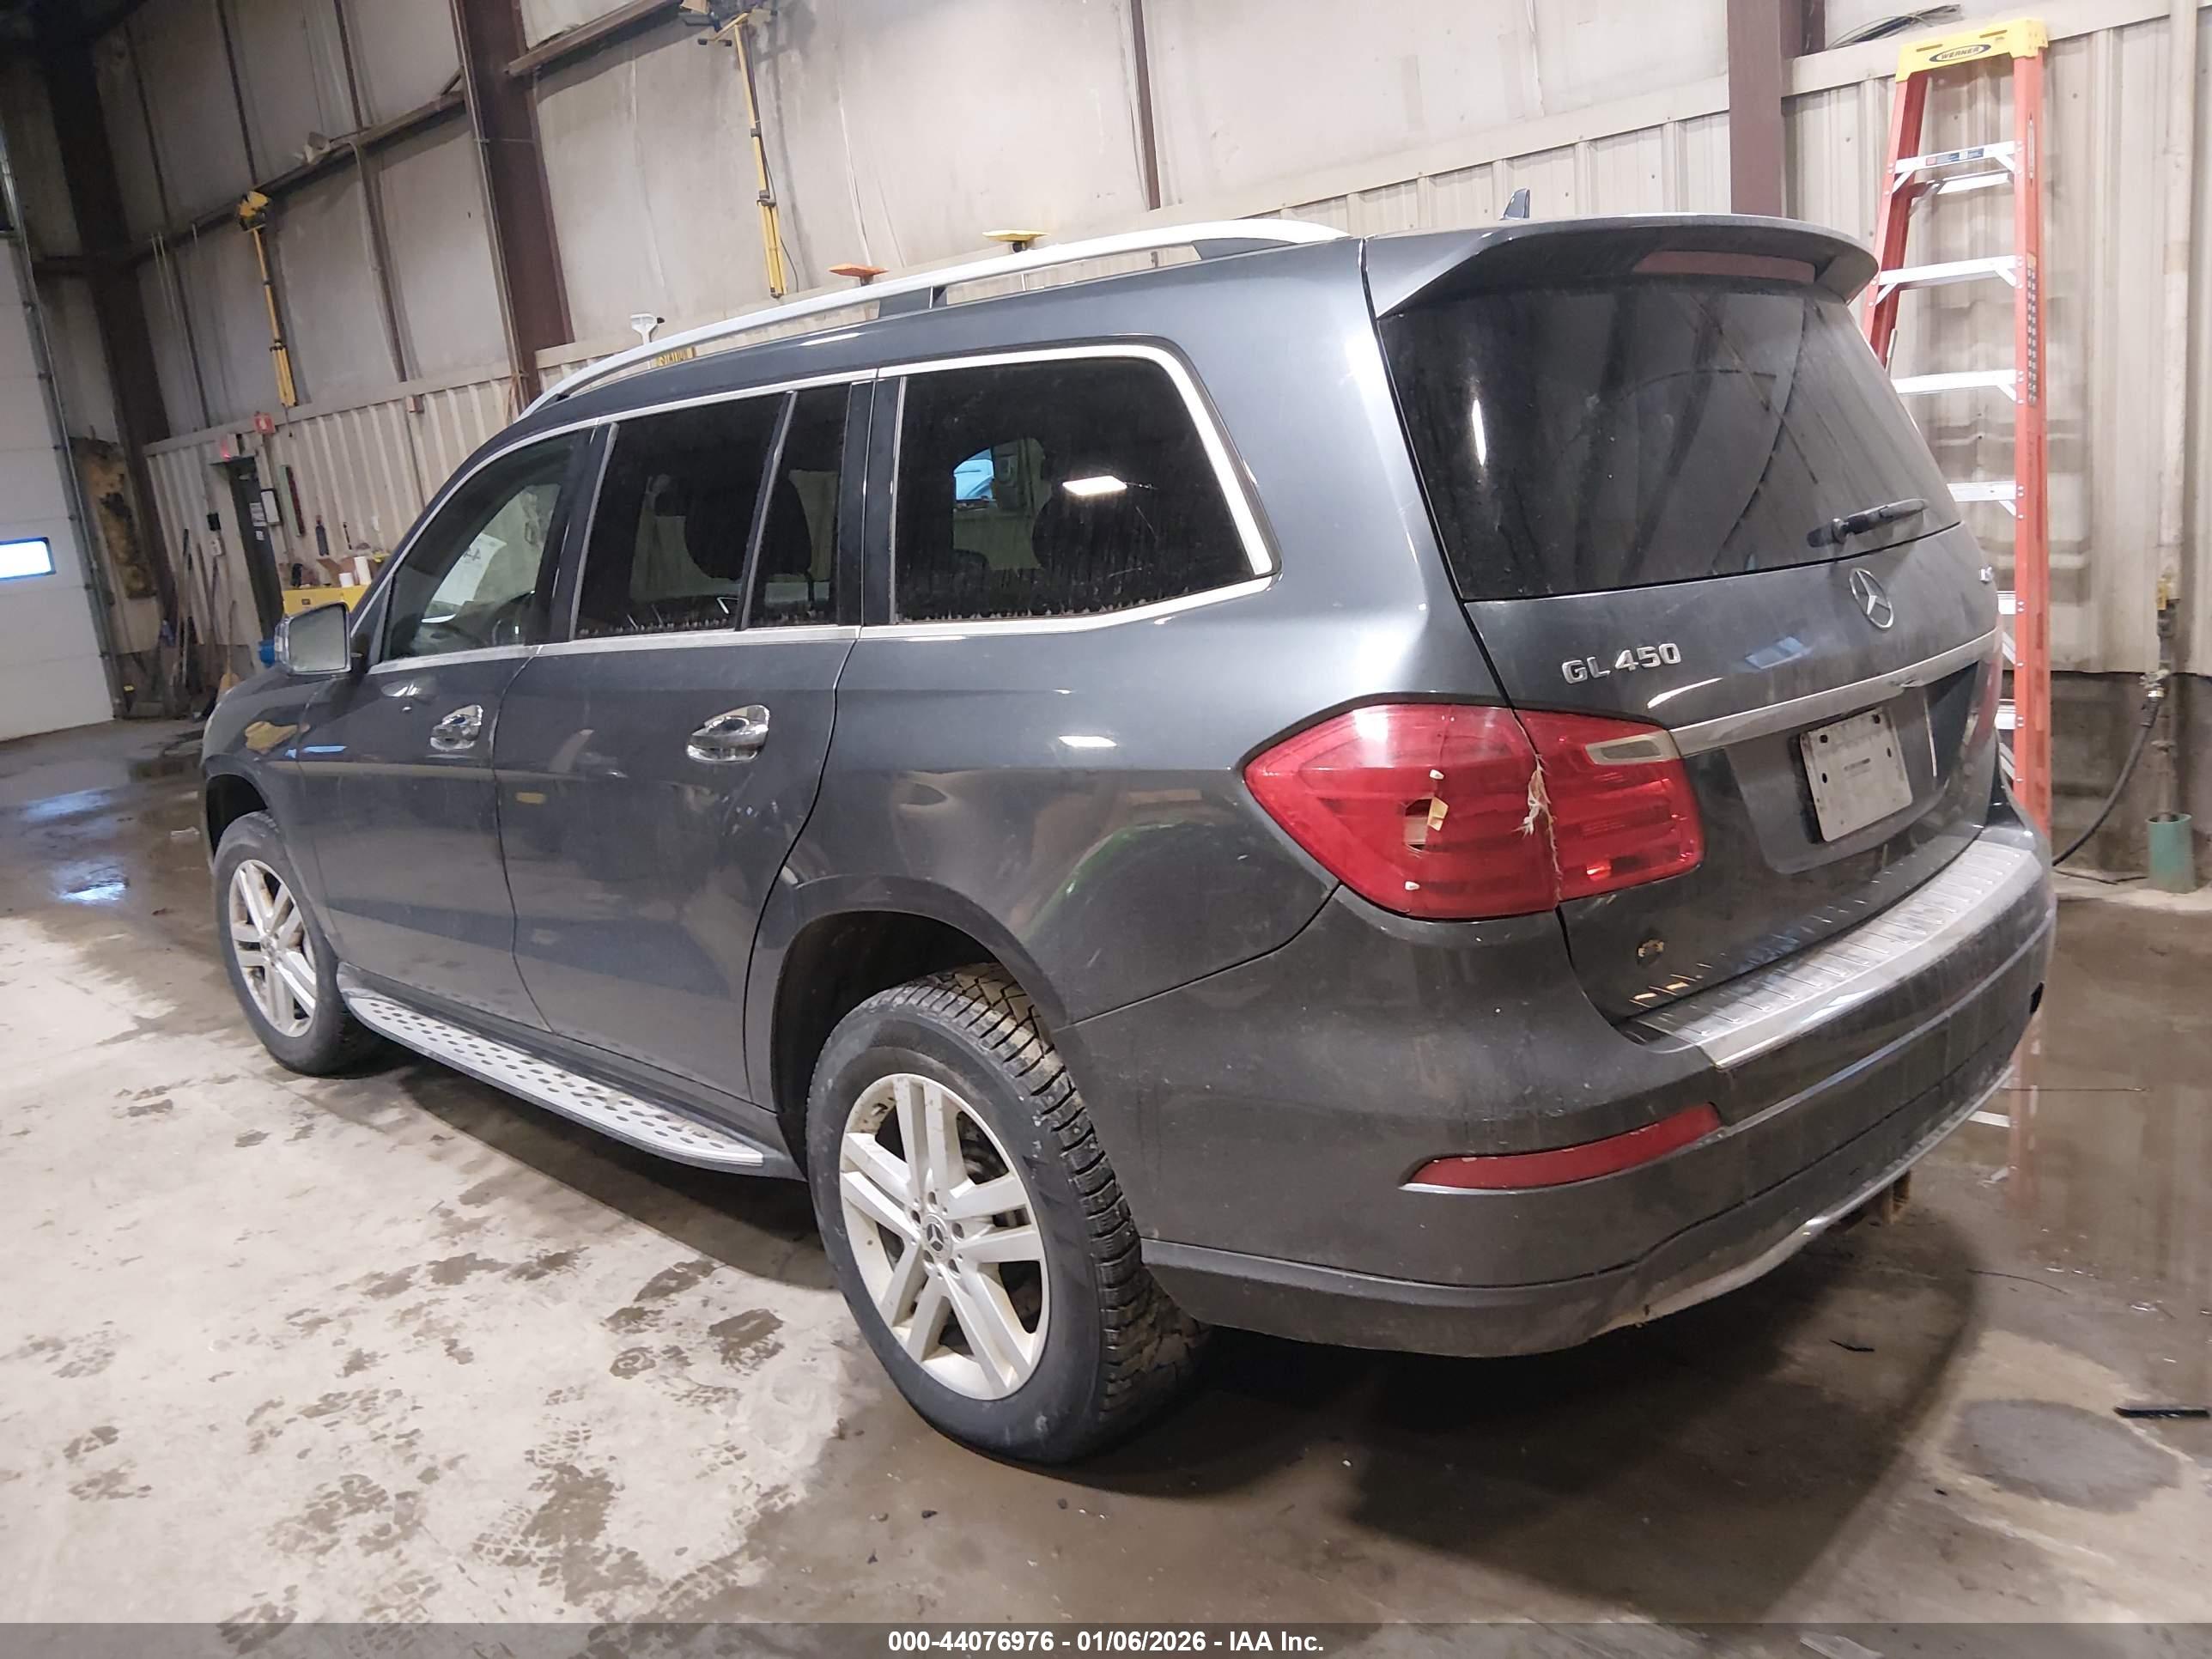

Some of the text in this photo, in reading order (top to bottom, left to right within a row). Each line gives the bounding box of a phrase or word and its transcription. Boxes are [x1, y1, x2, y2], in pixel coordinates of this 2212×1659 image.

[1941, 46, 1980, 60] WERNER
[1561, 642, 1682, 684] GL 450
